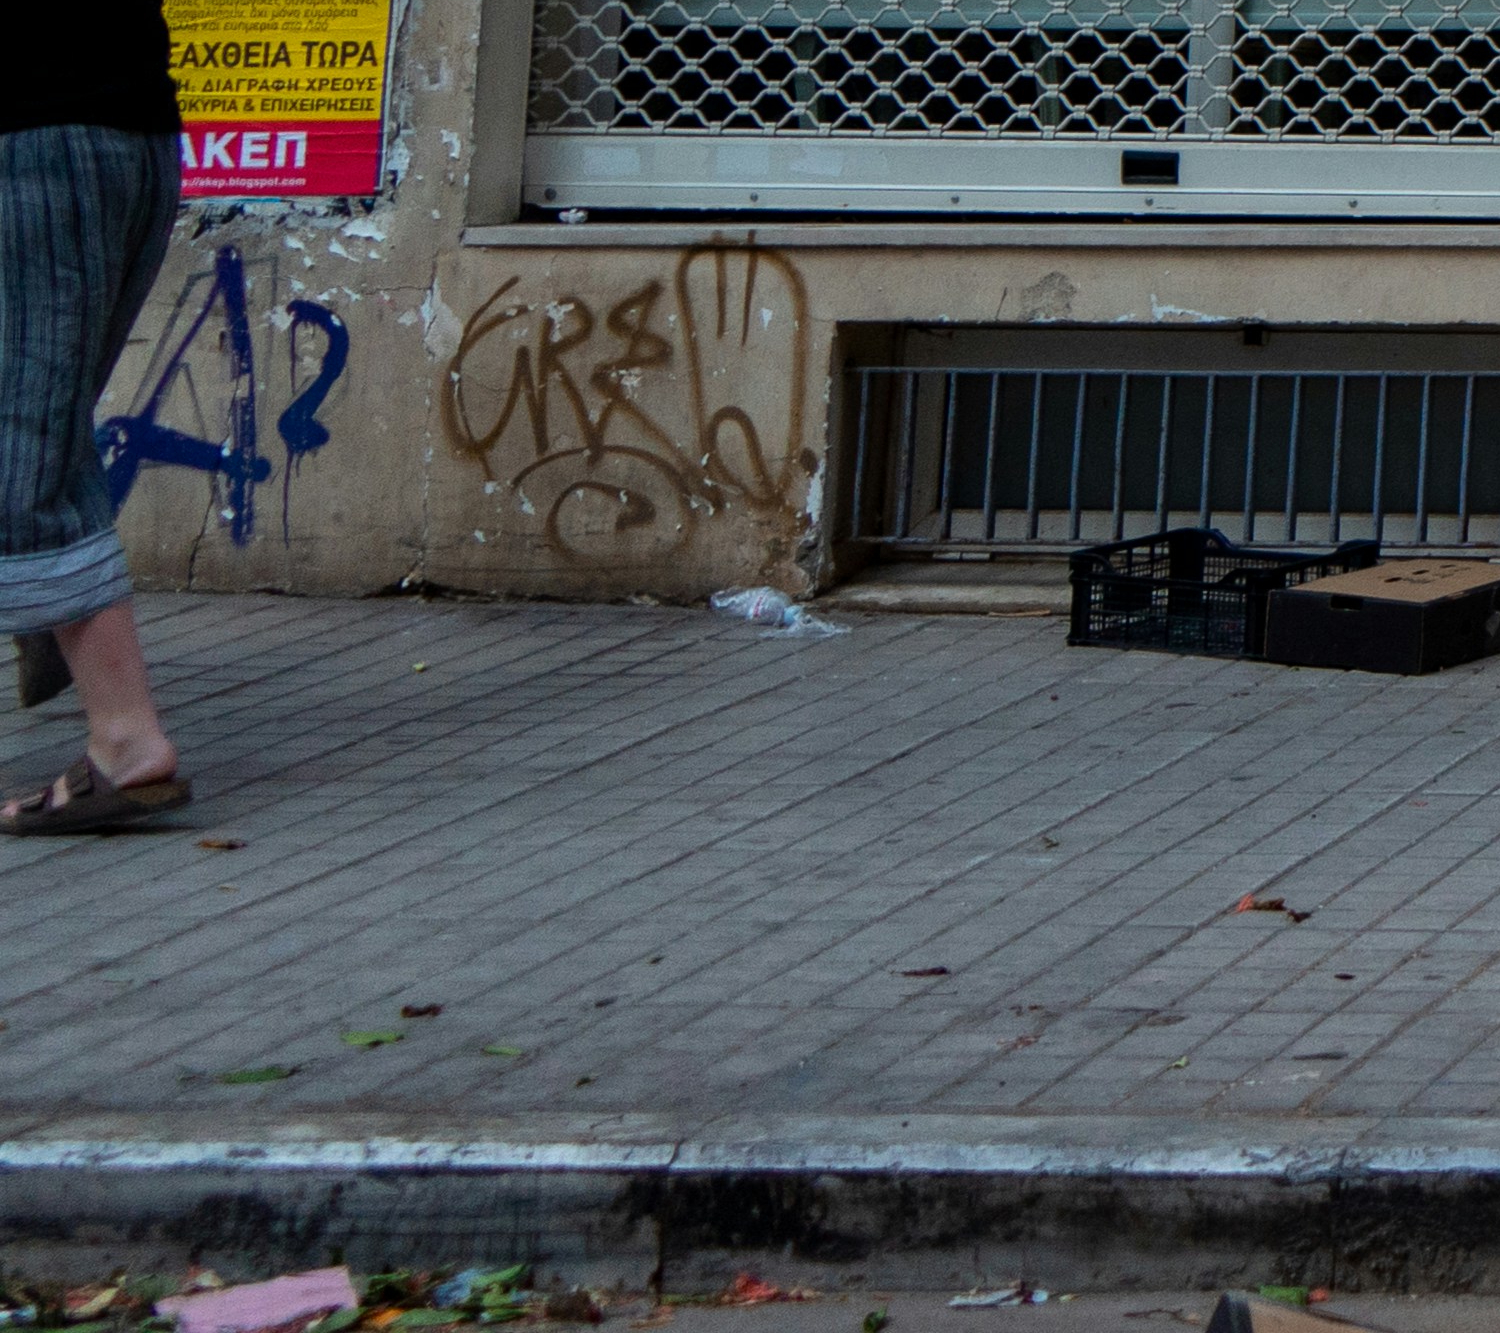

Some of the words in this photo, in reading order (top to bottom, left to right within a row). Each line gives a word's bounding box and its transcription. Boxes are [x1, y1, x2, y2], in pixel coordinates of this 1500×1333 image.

[168, 40, 292, 68] ΣΑΧΘΕΙΑ
[302, 40, 378, 68] ΤΩΡΑ
[202, 79, 298, 93] ΔΙΑΓΡΑΦΗ
[306, 78, 378, 91] ΧΡΕΟΥΣ
[179, 98, 238, 113] ΟΚΥΡΙΑ
[243, 99, 255, 111] &
[260, 98, 376, 112] ΕΠΙΧΕΙΡΗΣΕΙΣ
